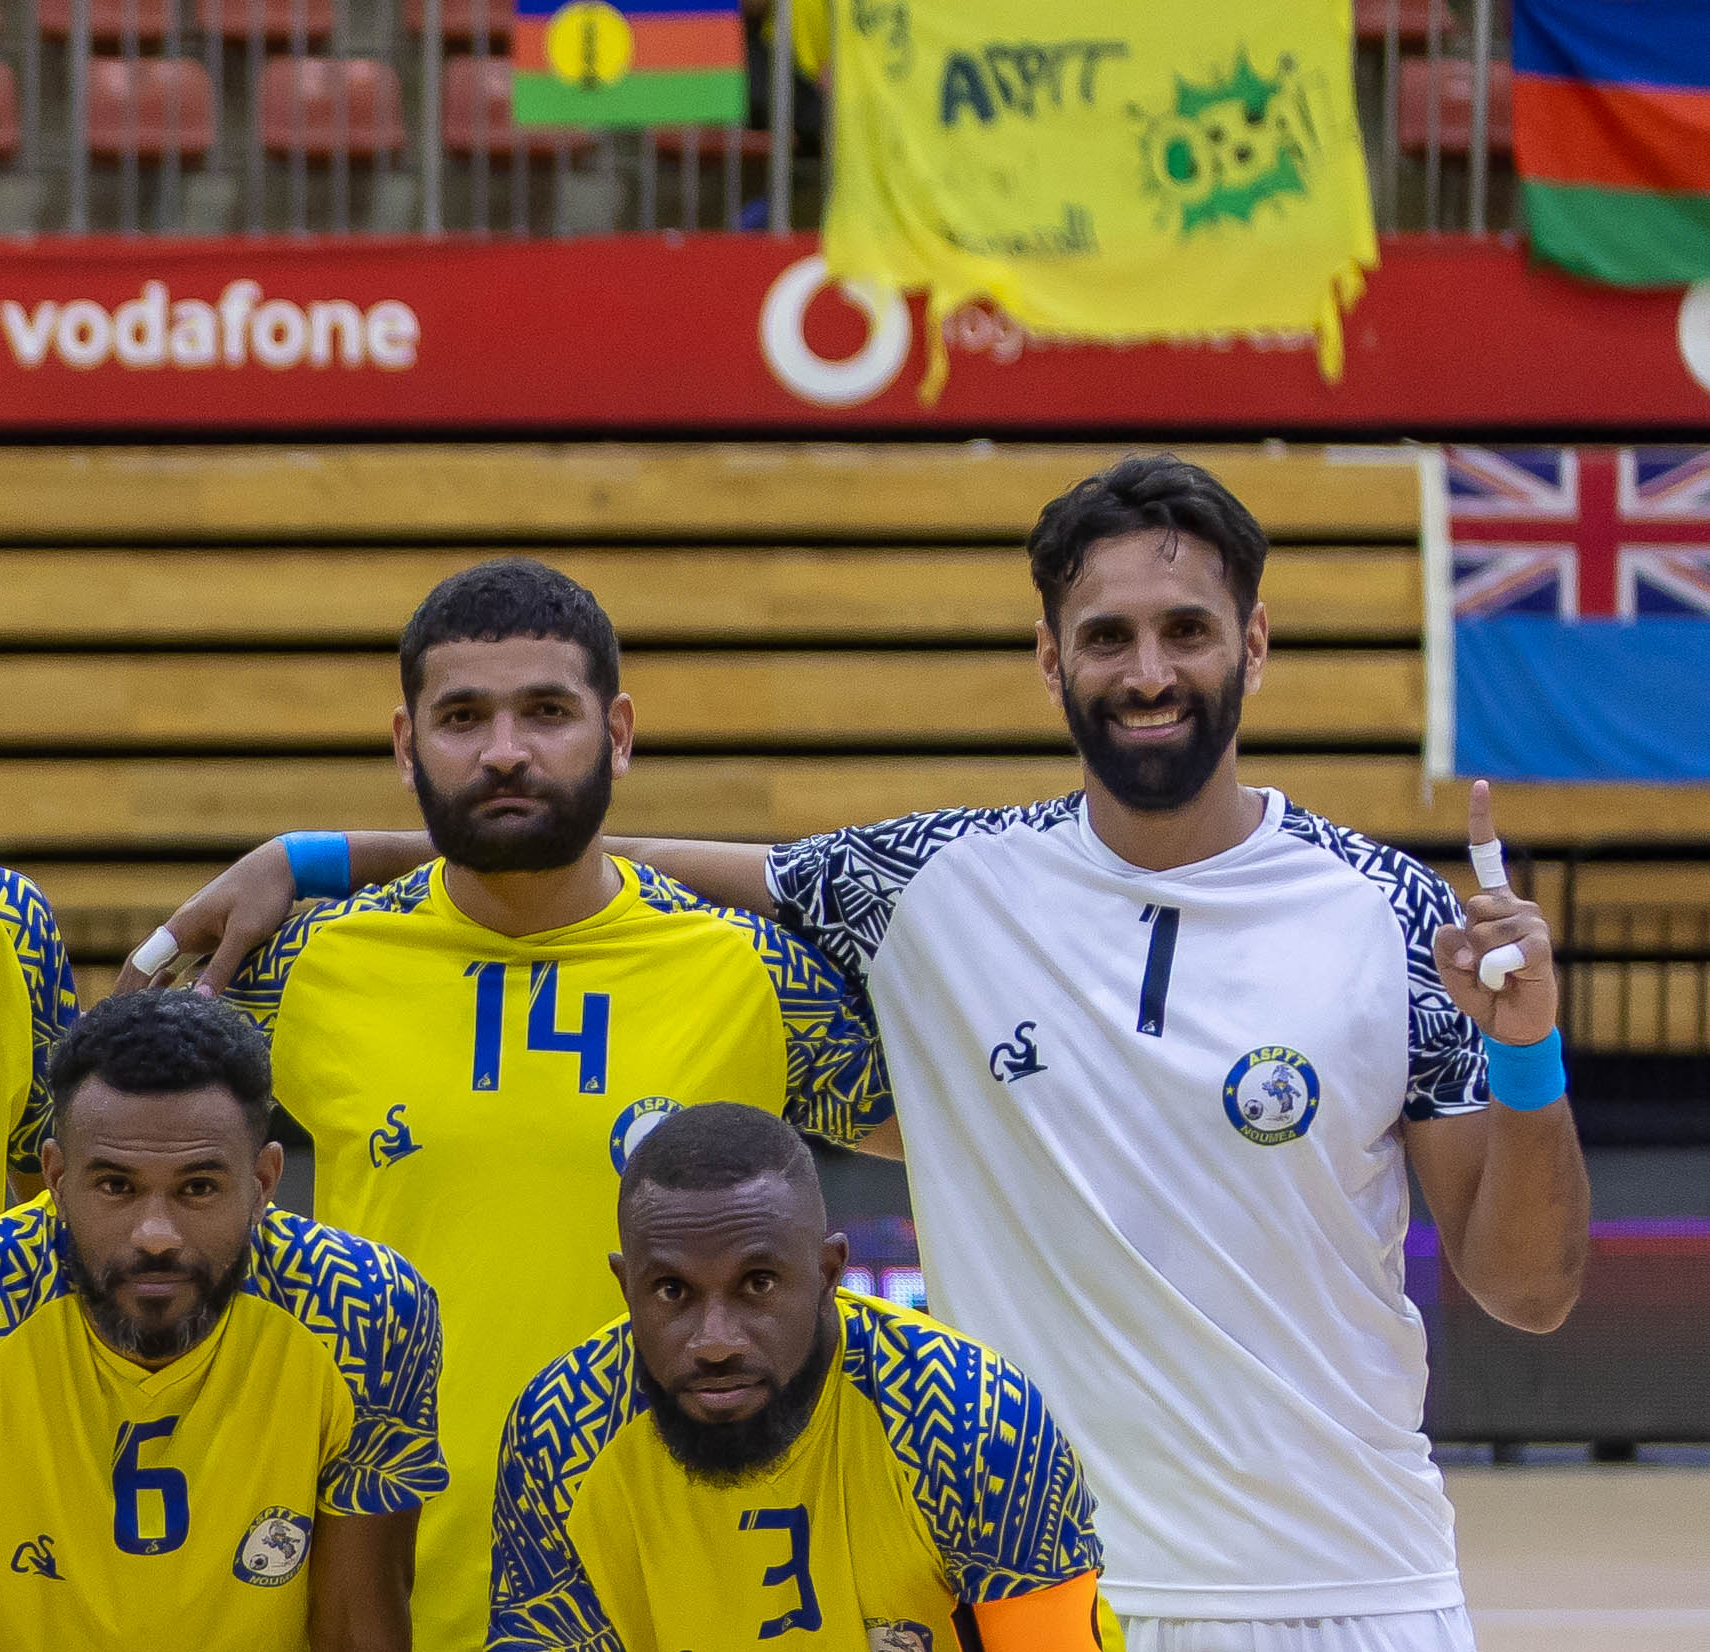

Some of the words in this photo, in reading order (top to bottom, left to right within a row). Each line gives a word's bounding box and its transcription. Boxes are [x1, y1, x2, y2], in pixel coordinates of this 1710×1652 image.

[0, 281, 419, 370] vodafone
[462, 959, 611, 1095] 14
[1136, 903, 1180, 1037] 1
[1248, 1046, 1309, 1067] ASPTT
[1239, 1123, 1297, 1145] NOUMEA
[112, 1415, 190, 1556] 6
[738, 1503, 823, 1640] 3
